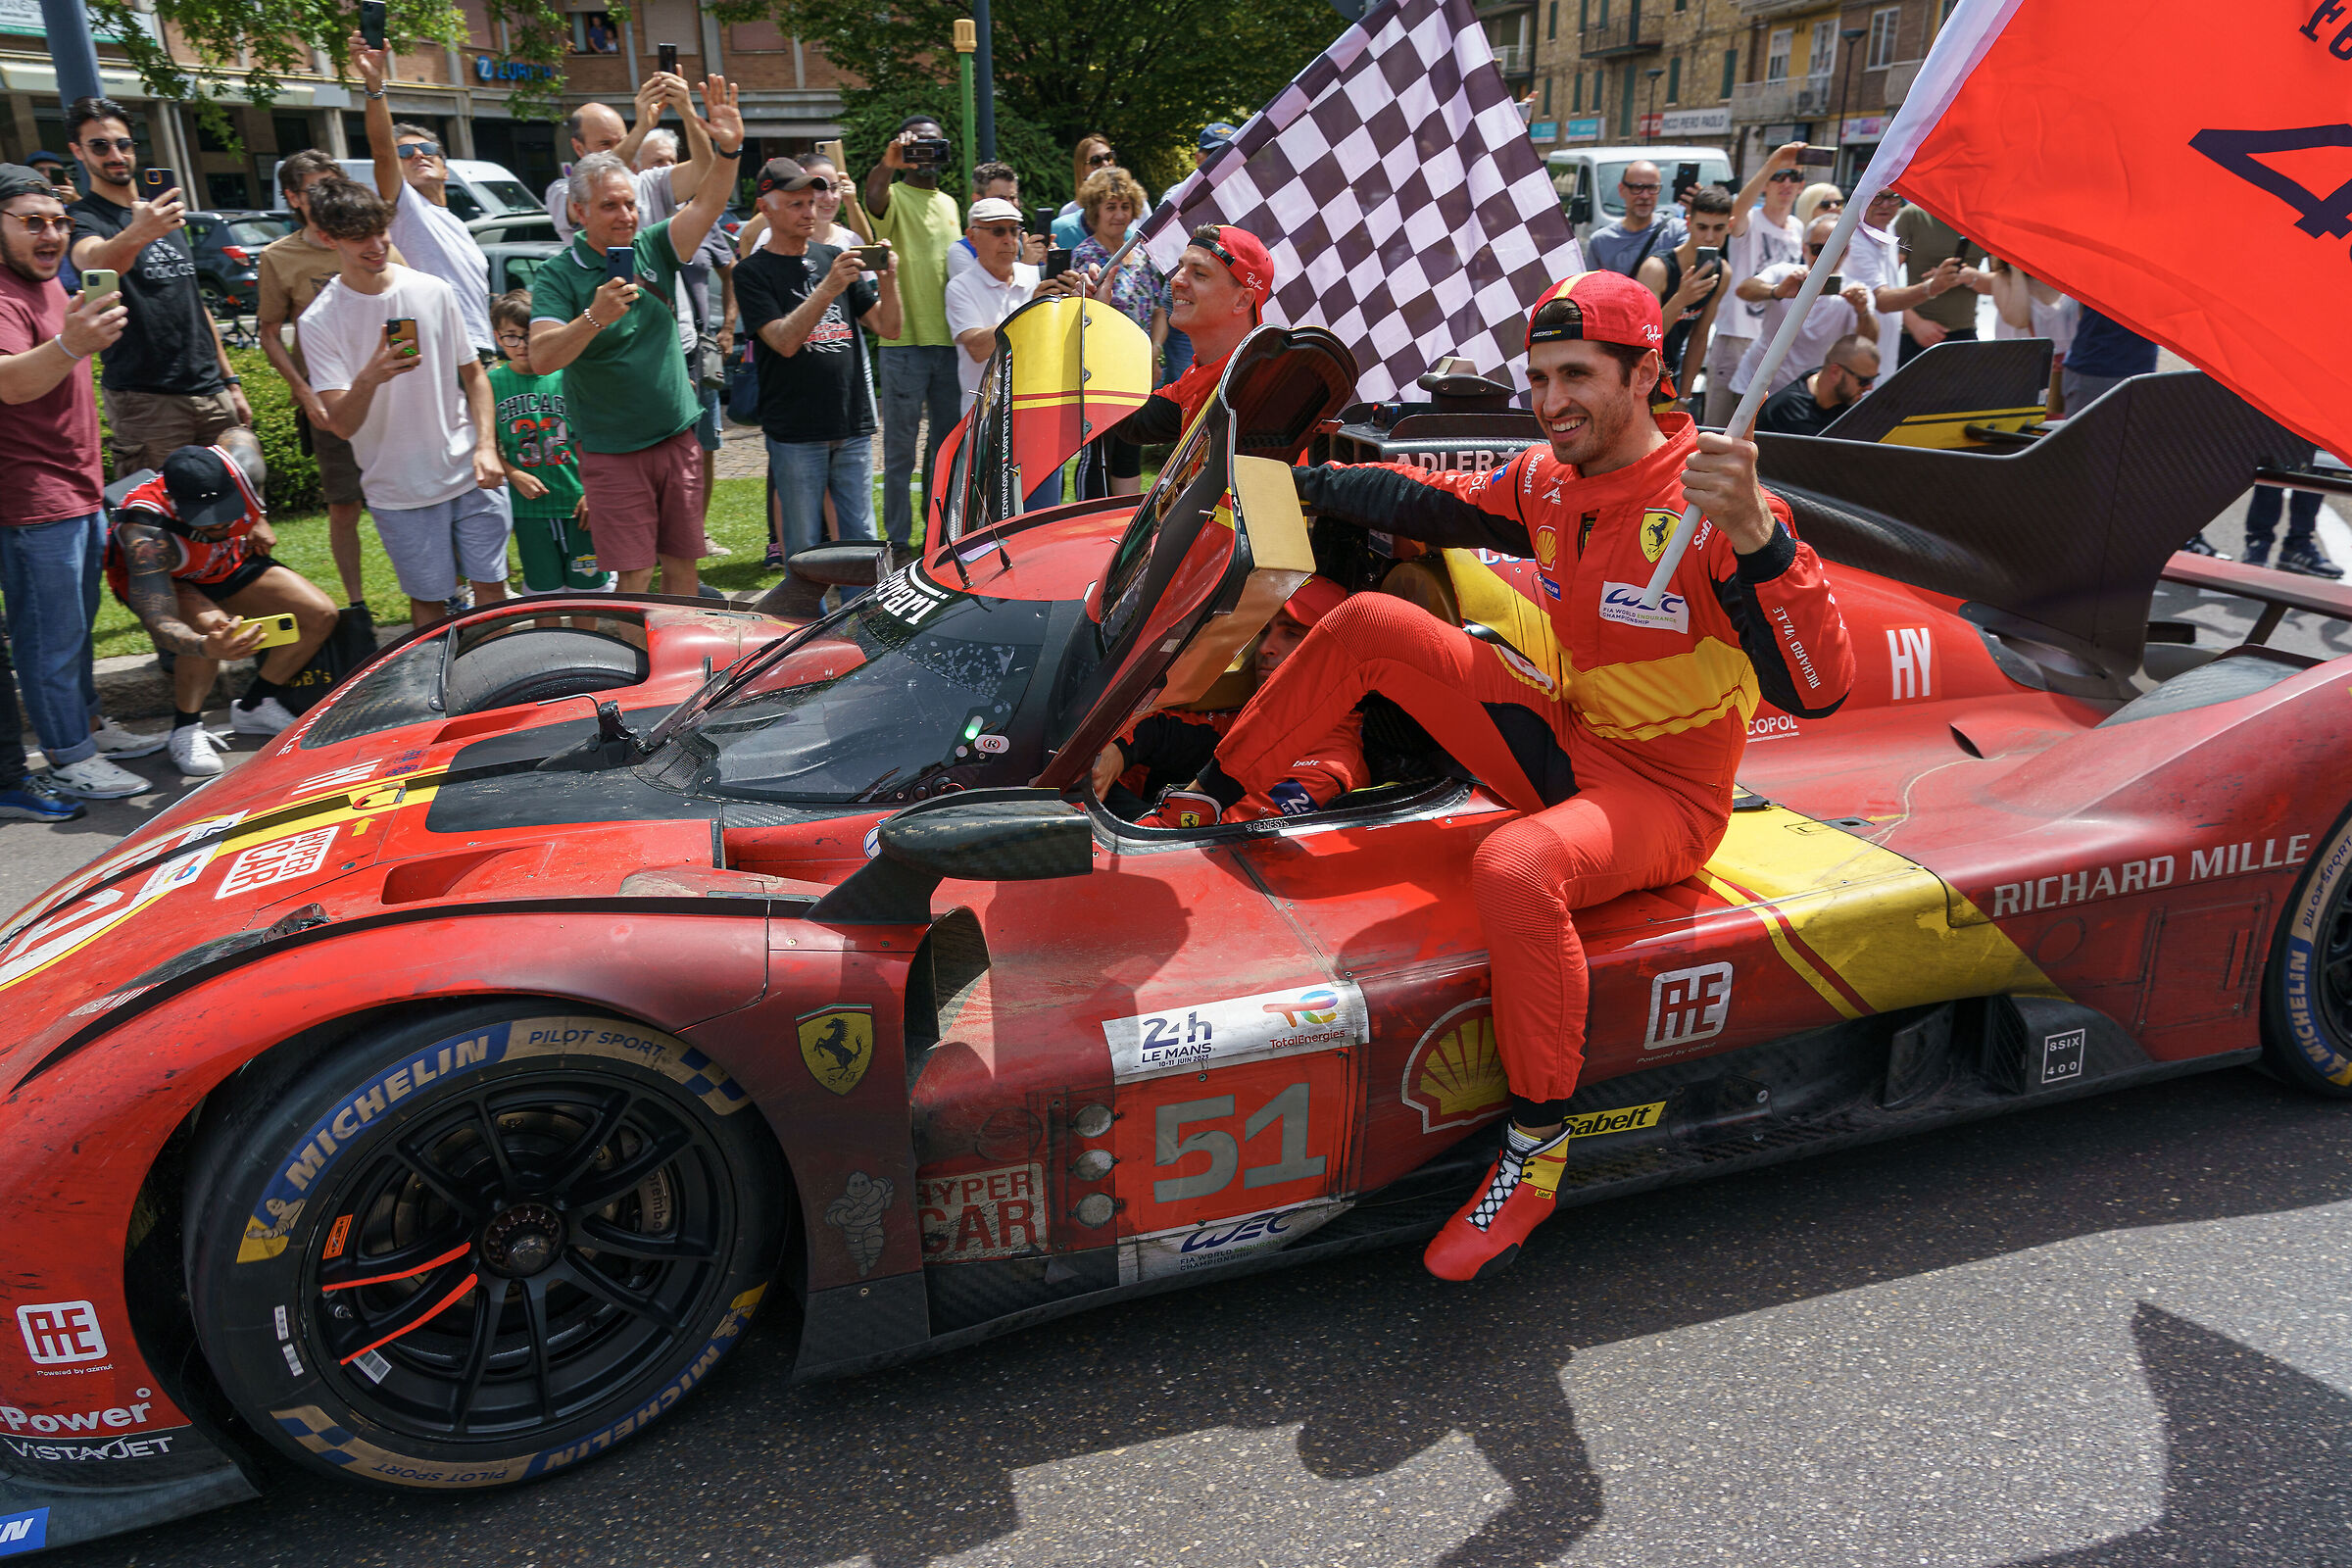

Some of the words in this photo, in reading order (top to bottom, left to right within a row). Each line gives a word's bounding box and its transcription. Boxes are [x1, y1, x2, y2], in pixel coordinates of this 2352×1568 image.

[497, 393, 568, 423] CHICAG
[511, 416, 569, 467] 32
[1692, 519, 1714, 551] Sab
[1602, 612, 1650, 625] CHAMPIONSHIP
[1637, 613, 1677, 624] ENDURANCE
[1788, 640, 1821, 689] RICHARD
[1886, 627, 1931, 700] HY
[1993, 855, 2175, 916] RICHARD
[2189, 833, 2310, 881] MILLE
[2289, 950, 2331, 1064] MICHELIN
[528, 1029, 593, 1046] PILOT
[598, 1031, 666, 1057] SPORT
[1142, 1051, 1163, 1063] LE
[1164, 1043, 1213, 1058] MANS
[1270, 1029, 1346, 1049] TotalEnergies
[2047, 1061, 2077, 1076] 400
[285, 1034, 490, 1192] MICHELIN
[1565, 1107, 1651, 1135] Sabelt
[1153, 1082, 1327, 1203] 51
[917, 1170, 1036, 1207] HYPER
[918, 1200, 1039, 1254] CAR
[1180, 1257, 1196, 1266] FIA
[1198, 1249, 1233, 1262] WORLD
[1180, 1250, 1252, 1271] CHAMPIONSHIP
[37, 1368, 72, 1377] Powered
[86, 1363, 114, 1373] azimut
[544, 1347, 720, 1470] MICHELIN
